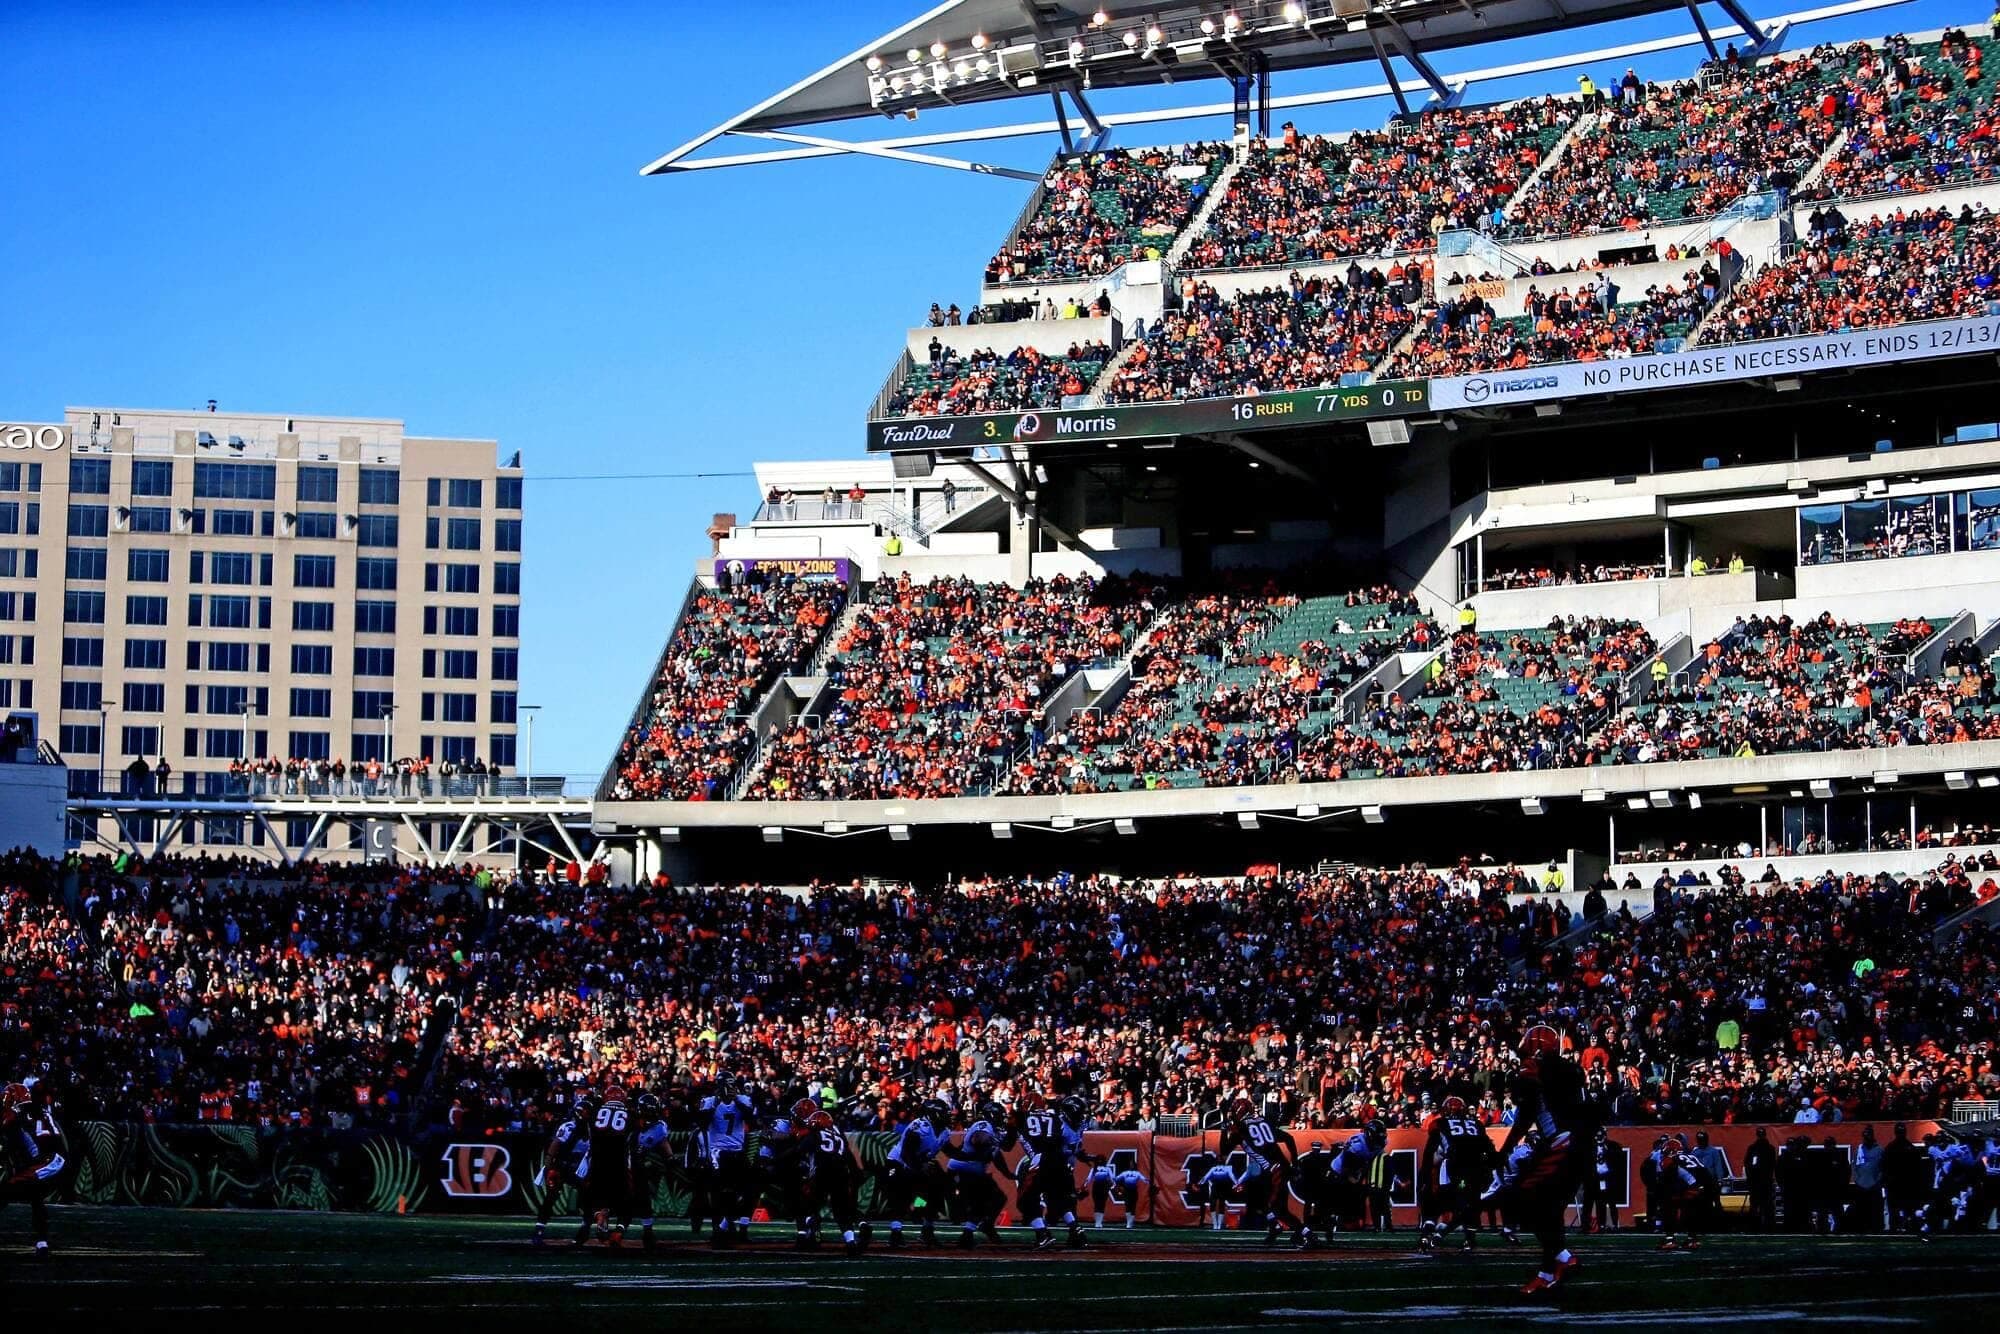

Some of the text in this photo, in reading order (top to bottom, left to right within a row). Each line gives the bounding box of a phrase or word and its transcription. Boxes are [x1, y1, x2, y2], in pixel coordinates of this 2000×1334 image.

[1584, 369, 1611, 386] NO
[1620, 356, 1726, 383] PURCHASE
[1734, 341, 1857, 370] NECESSARY.
[1865, 334, 1919, 355] ENDS
[1493, 376, 1559, 394] mazda
[883, 424, 954, 445] FanDuel
[1056, 415, 1116, 434] Morris
[1231, 403, 1253, 420] 16
[1256, 402, 1293, 416] RUSH
[1315, 394, 1338, 412] 77
[1342, 395, 1369, 407] YDS
[1382, 389, 1394, 406] 0
[1404, 390, 1423, 402] TD
[595, 1108, 628, 1131] 96
[1027, 1116, 1054, 1137] 97
[1448, 1119, 1478, 1136] 55
[1248, 1121, 1275, 1147] 90
[440, 1144, 513, 1197] B
